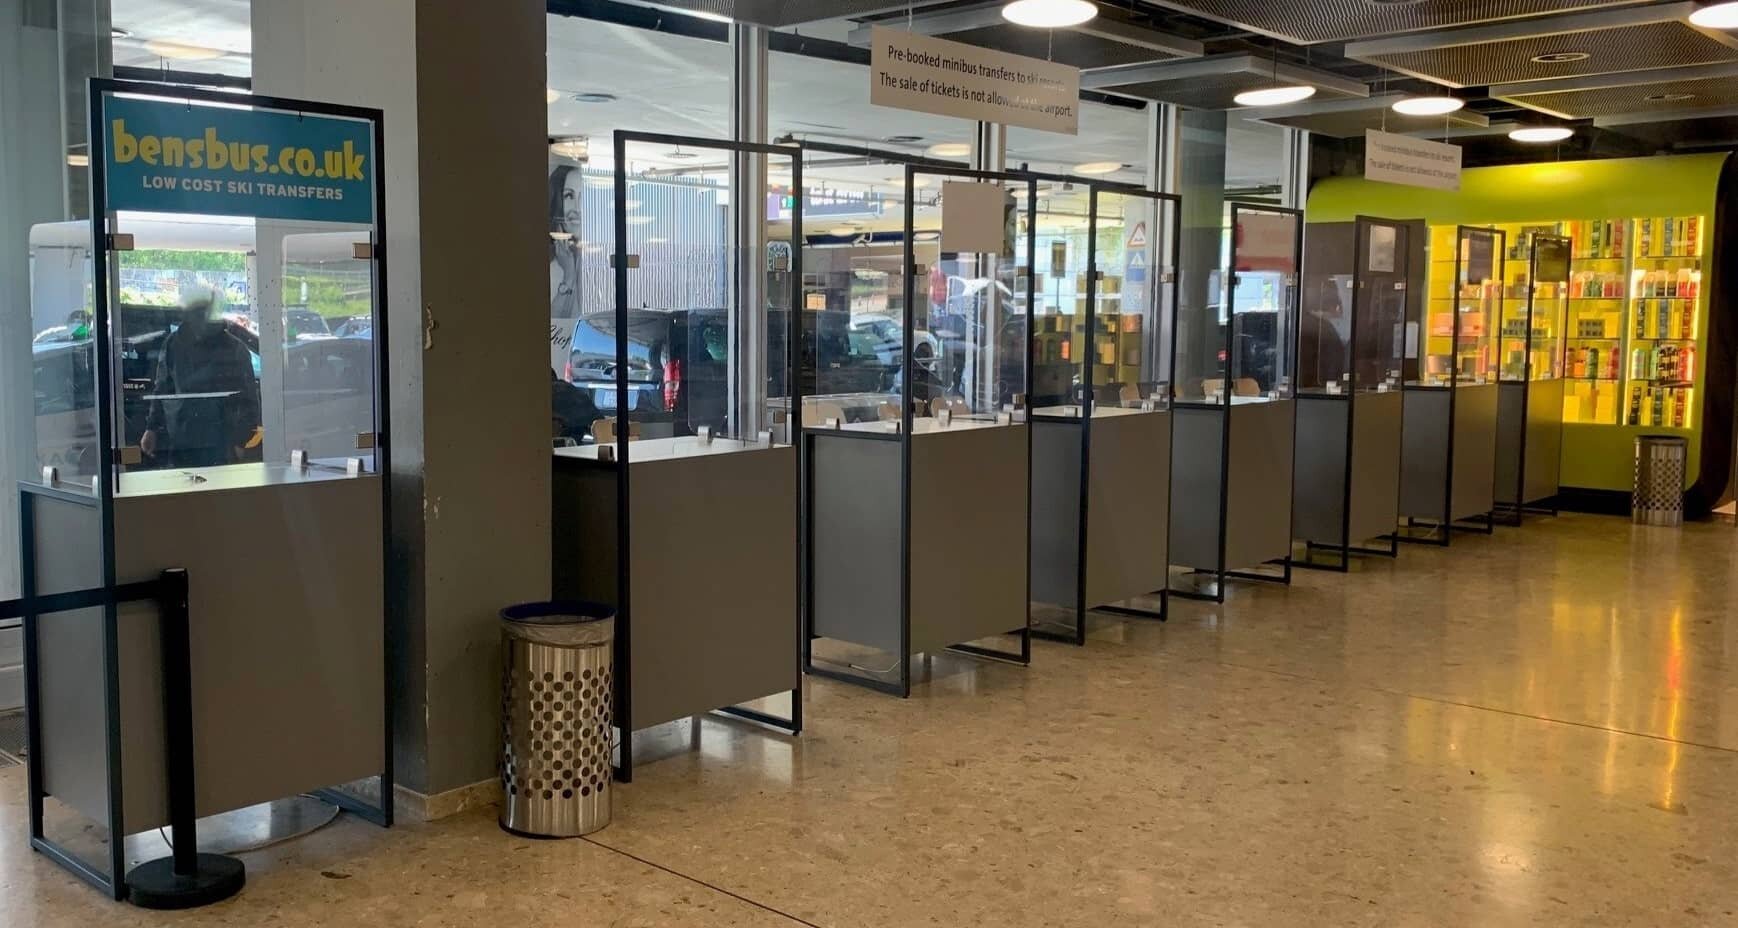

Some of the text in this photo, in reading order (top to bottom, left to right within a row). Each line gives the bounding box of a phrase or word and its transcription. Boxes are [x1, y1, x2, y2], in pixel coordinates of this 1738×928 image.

[888, 45, 940, 68] Pre-booked
[942, 57, 977, 75] minibus
[979, 63, 1015, 82] transfers
[1017, 72, 1026, 84] to
[880, 71, 897, 88] The
[899, 76, 918, 91] sale
[919, 79, 930, 92] of
[931, 82, 960, 98] tickets
[962, 86, 969, 99] is
[971, 90, 985, 103] not
[1045, 104, 1073, 118] airport.
[112, 118, 366, 181] bensbus.co.uk
[142, 175, 344, 200] LOW COST SKI TRANSFERS
